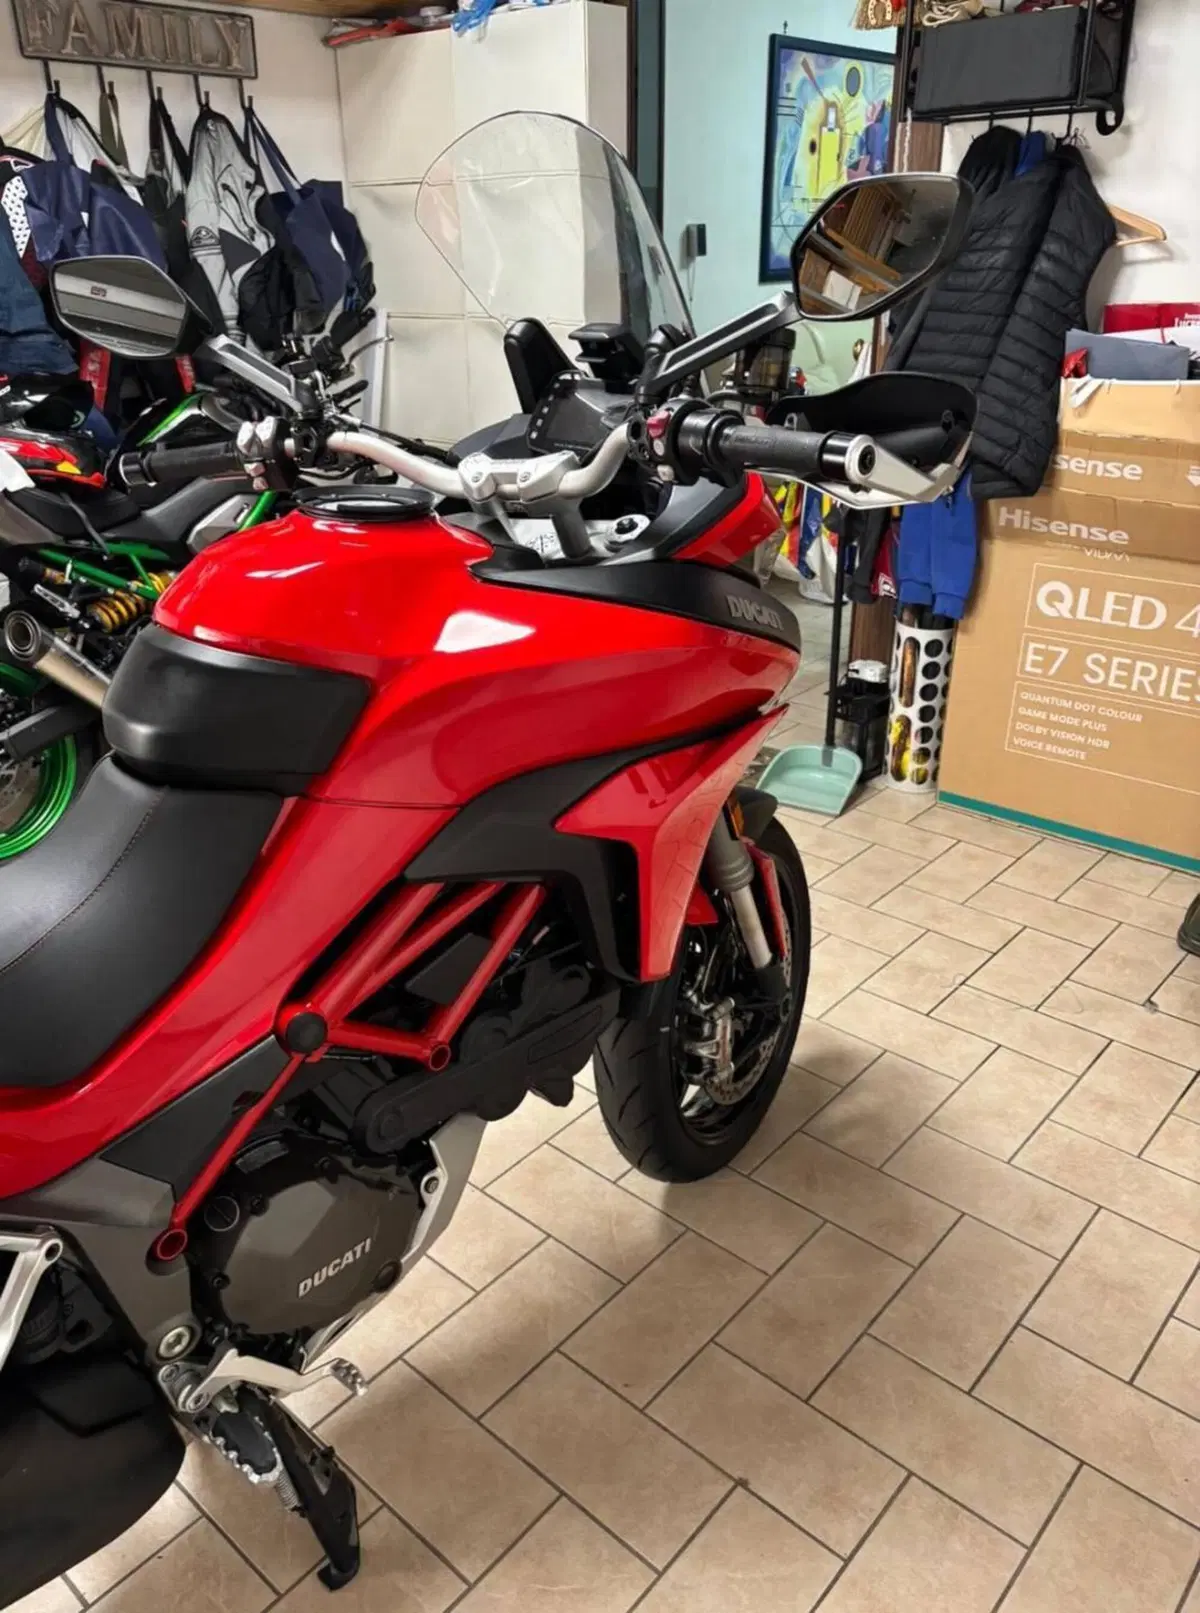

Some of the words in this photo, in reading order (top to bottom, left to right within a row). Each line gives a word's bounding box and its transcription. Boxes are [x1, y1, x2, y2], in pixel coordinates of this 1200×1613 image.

[26, 0, 251, 70] FAMILY
[999, 506, 1129, 545] Hisense
[726, 594, 784, 631] DUCATI
[1036, 580, 1167, 630] QLED
[1024, 642, 1070, 676] E7
[1083, 652, 1200, 702] SERIE
[1018, 706, 1048, 720] GAME
[1049, 713, 1080, 726] MODE
[1082, 719, 1108, 732] PLUS
[1020, 691, 1072, 709] QUANTUM
[1074, 701, 1096, 713] DOT
[1098, 706, 1144, 722] COLOUR
[1013, 735, 1043, 750] VOICE
[1045, 743, 1088, 760] REMOTE
[1015, 721, 1049, 735] DOLBY
[1050, 728, 1086, 744] VISION
[1087, 737, 1110, 749] HDR
[298, 1237, 372, 1299] DUCATI
